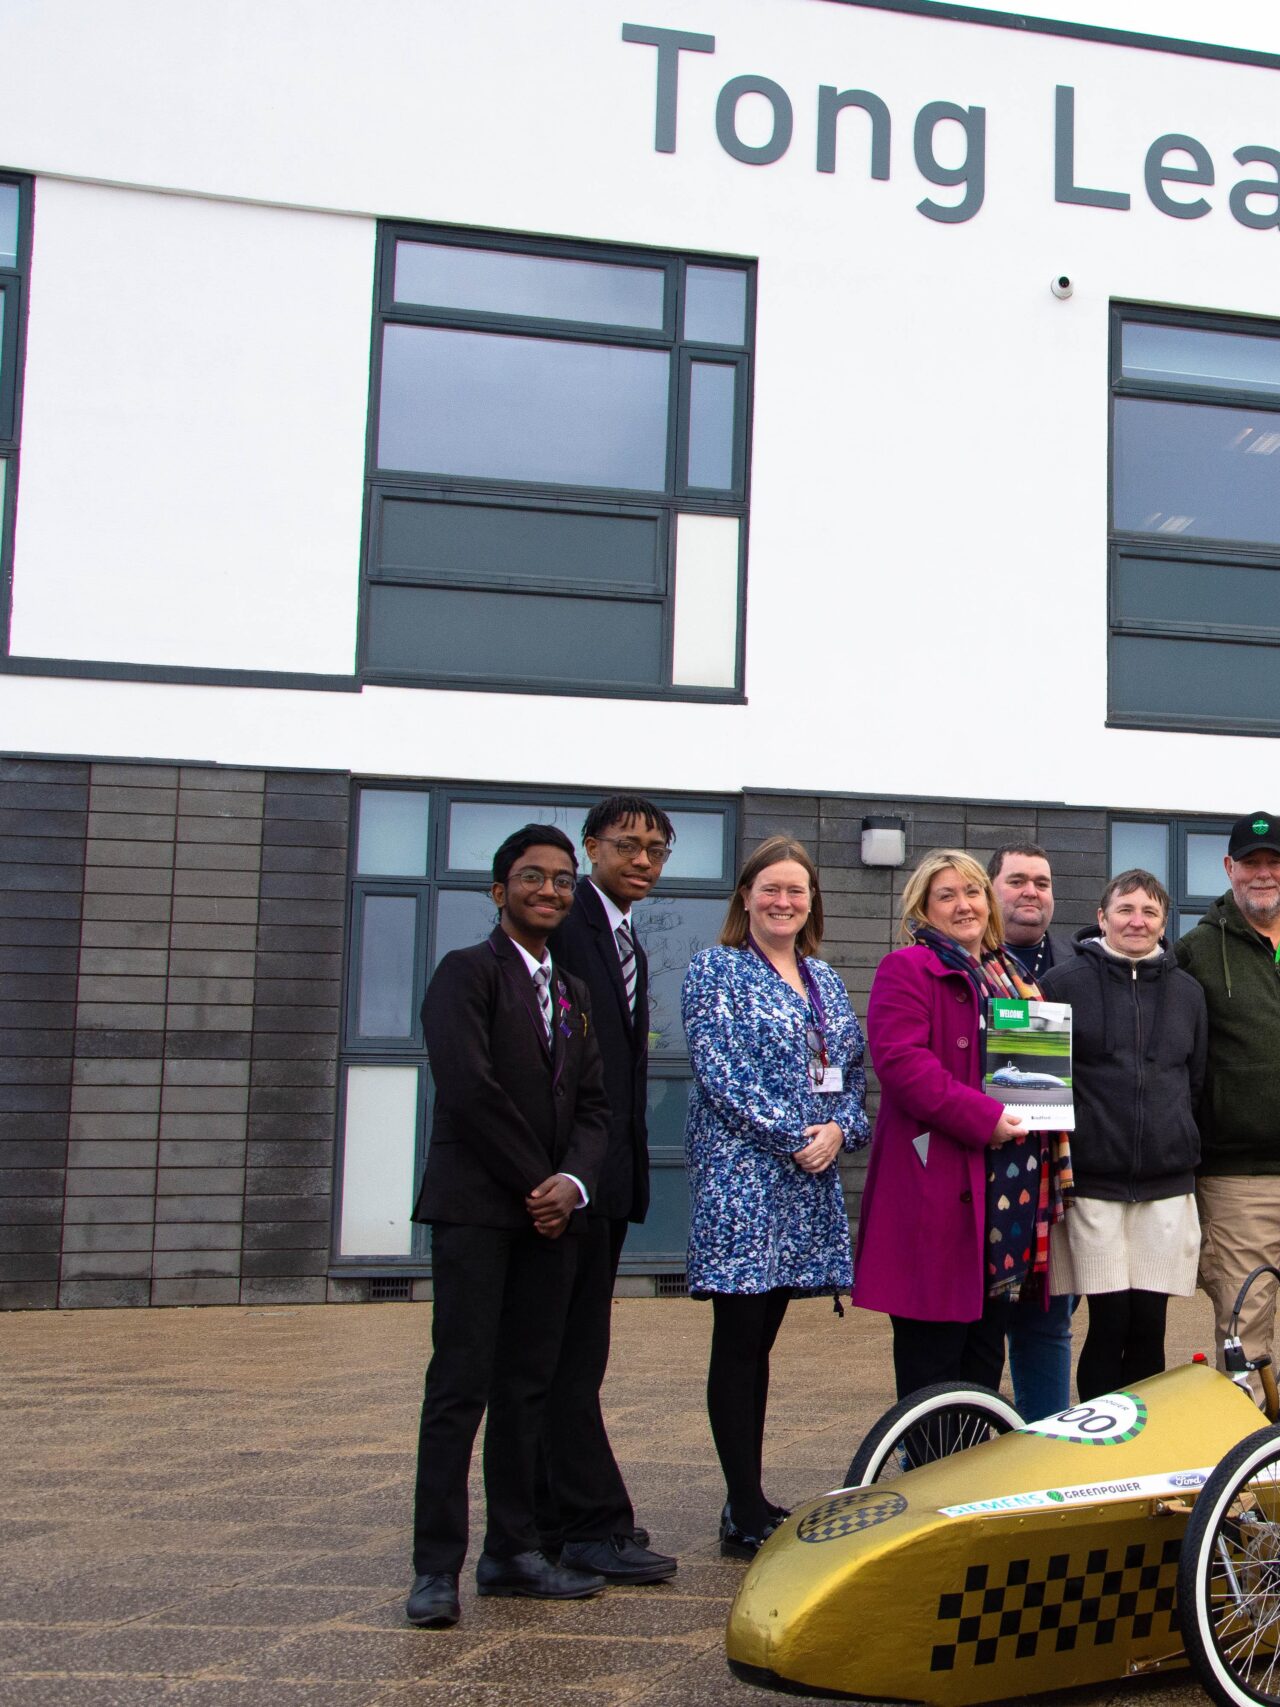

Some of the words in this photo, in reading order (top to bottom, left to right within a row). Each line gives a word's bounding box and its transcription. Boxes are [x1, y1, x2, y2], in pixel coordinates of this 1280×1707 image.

[622, 23, 986, 225] Tong
[999, 1009, 1024, 1019] WELCOME
[947, 1494, 1045, 1515] SIEMENS
[1064, 1482, 1142, 1499] GREENPOWER
[1175, 1474, 1203, 1487] Ford
